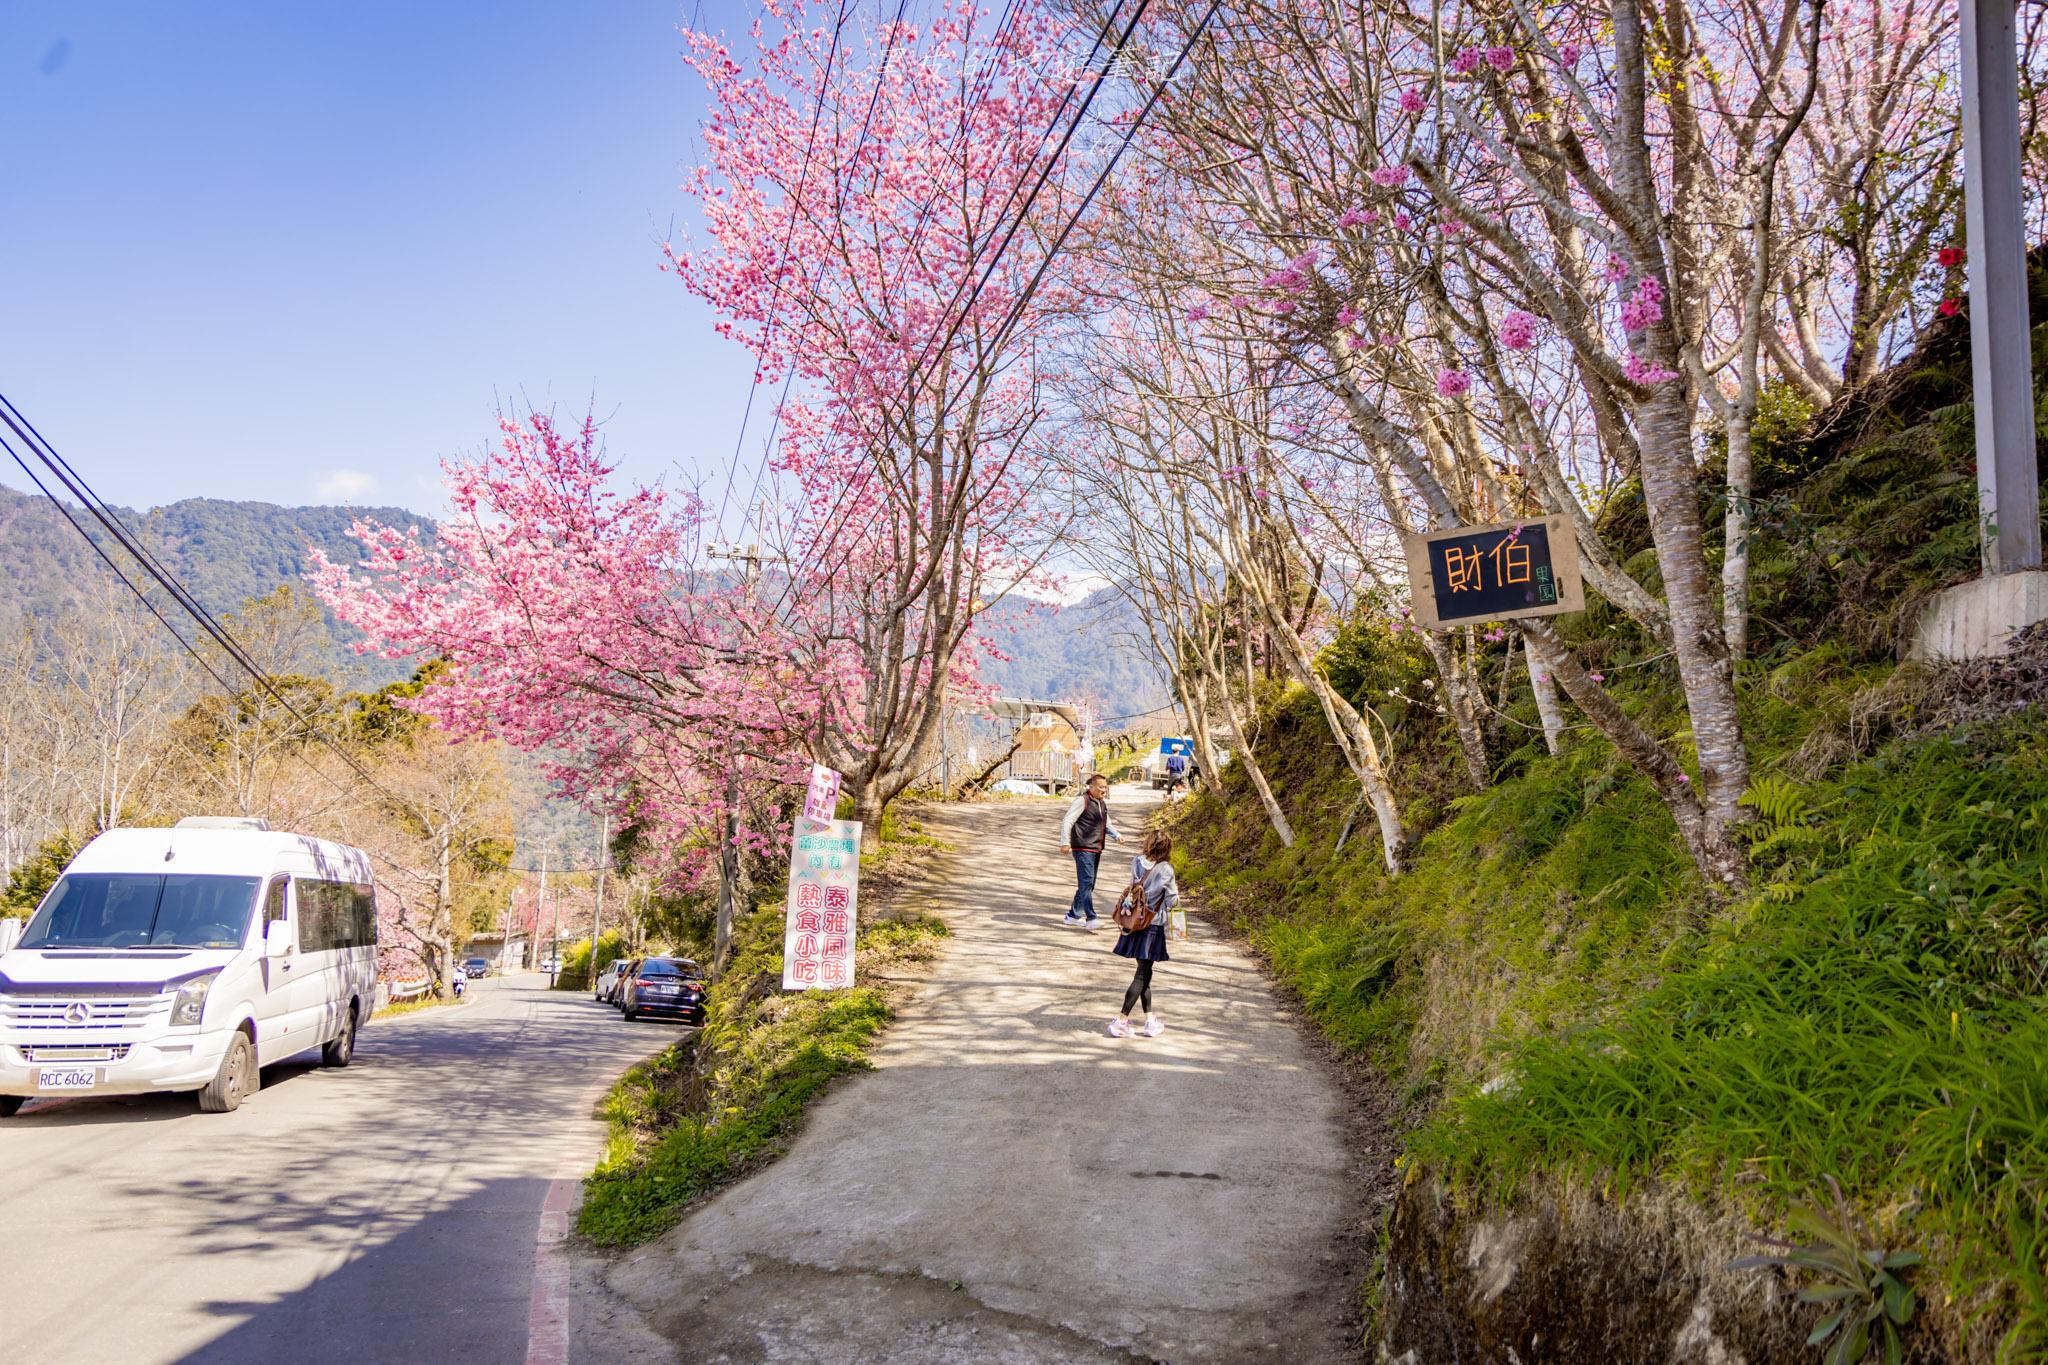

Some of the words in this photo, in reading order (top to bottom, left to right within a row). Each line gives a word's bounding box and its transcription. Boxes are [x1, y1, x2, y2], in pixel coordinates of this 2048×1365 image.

[1445, 539, 1531, 593] 財伯
[826, 786, 836, 799] P
[793, 884, 822, 984] 熱食小吃
[822, 885, 849, 984] 泰雅風味
